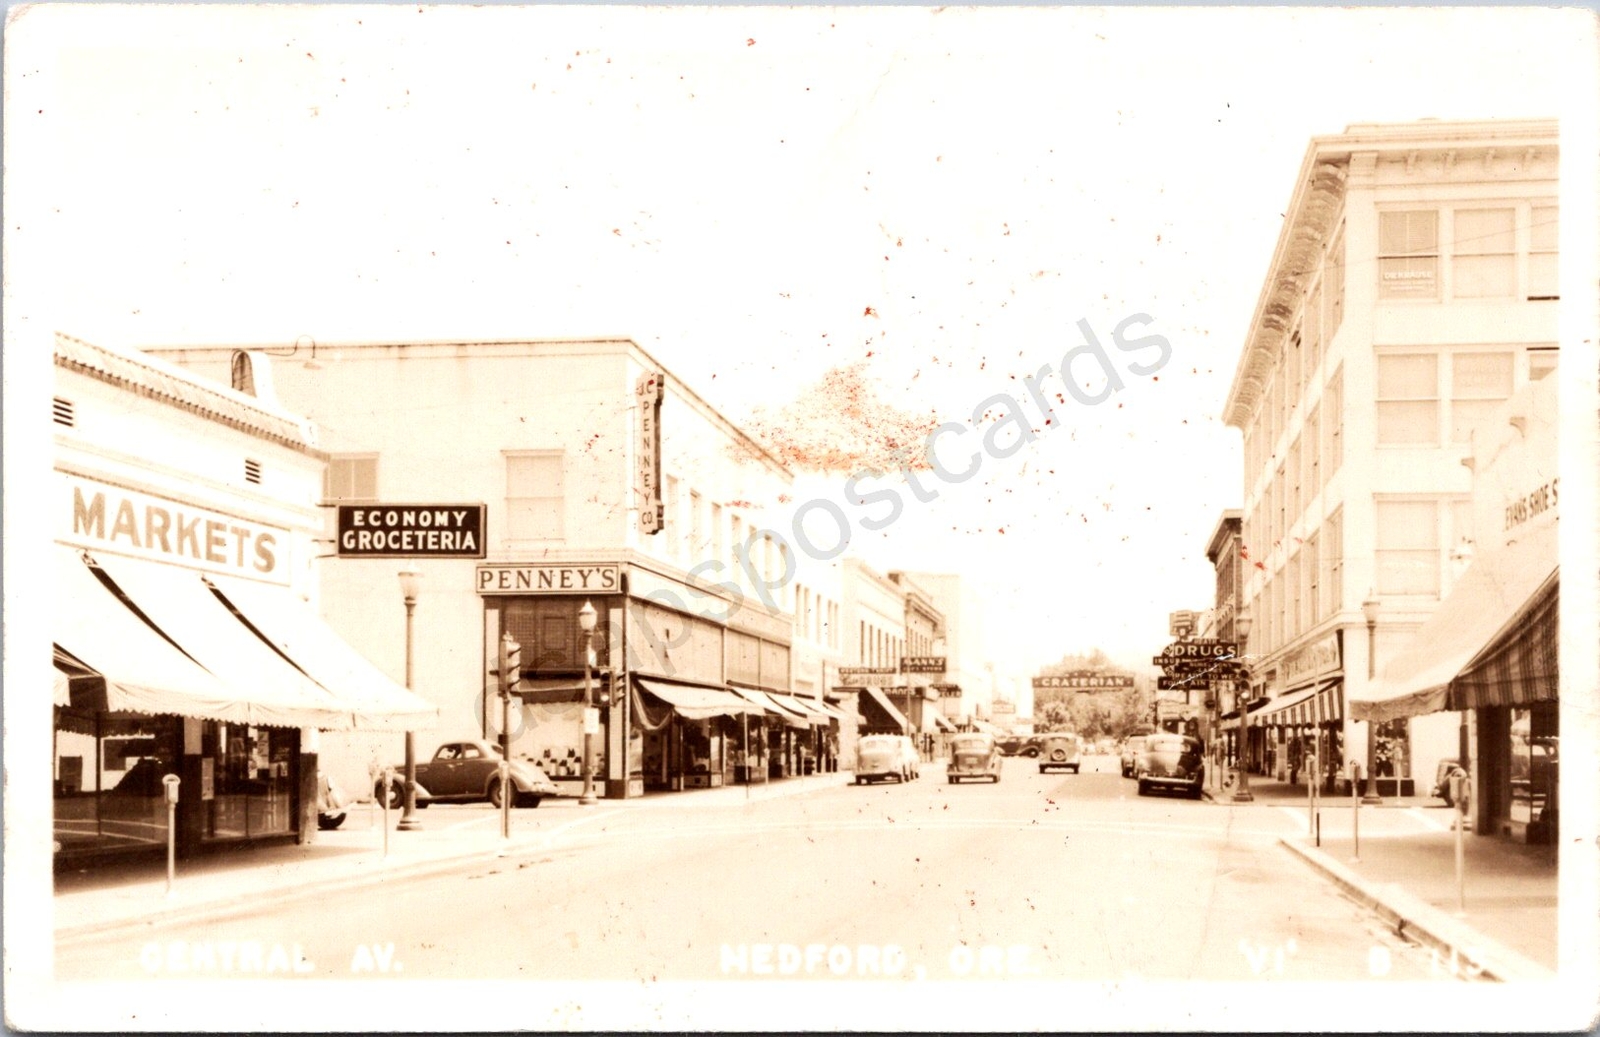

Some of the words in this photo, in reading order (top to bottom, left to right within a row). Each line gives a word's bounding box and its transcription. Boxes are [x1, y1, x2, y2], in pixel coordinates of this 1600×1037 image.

[353, 510, 467, 527] ECONOMY
[73, 486, 277, 574] MARKETS
[343, 531, 476, 550] GROCETERIA
[479, 569, 616, 590] PENNEY'S
[1175, 645, 1236, 656] DRUGS
[1042, 677, 1125, 687] CRATERIAN
